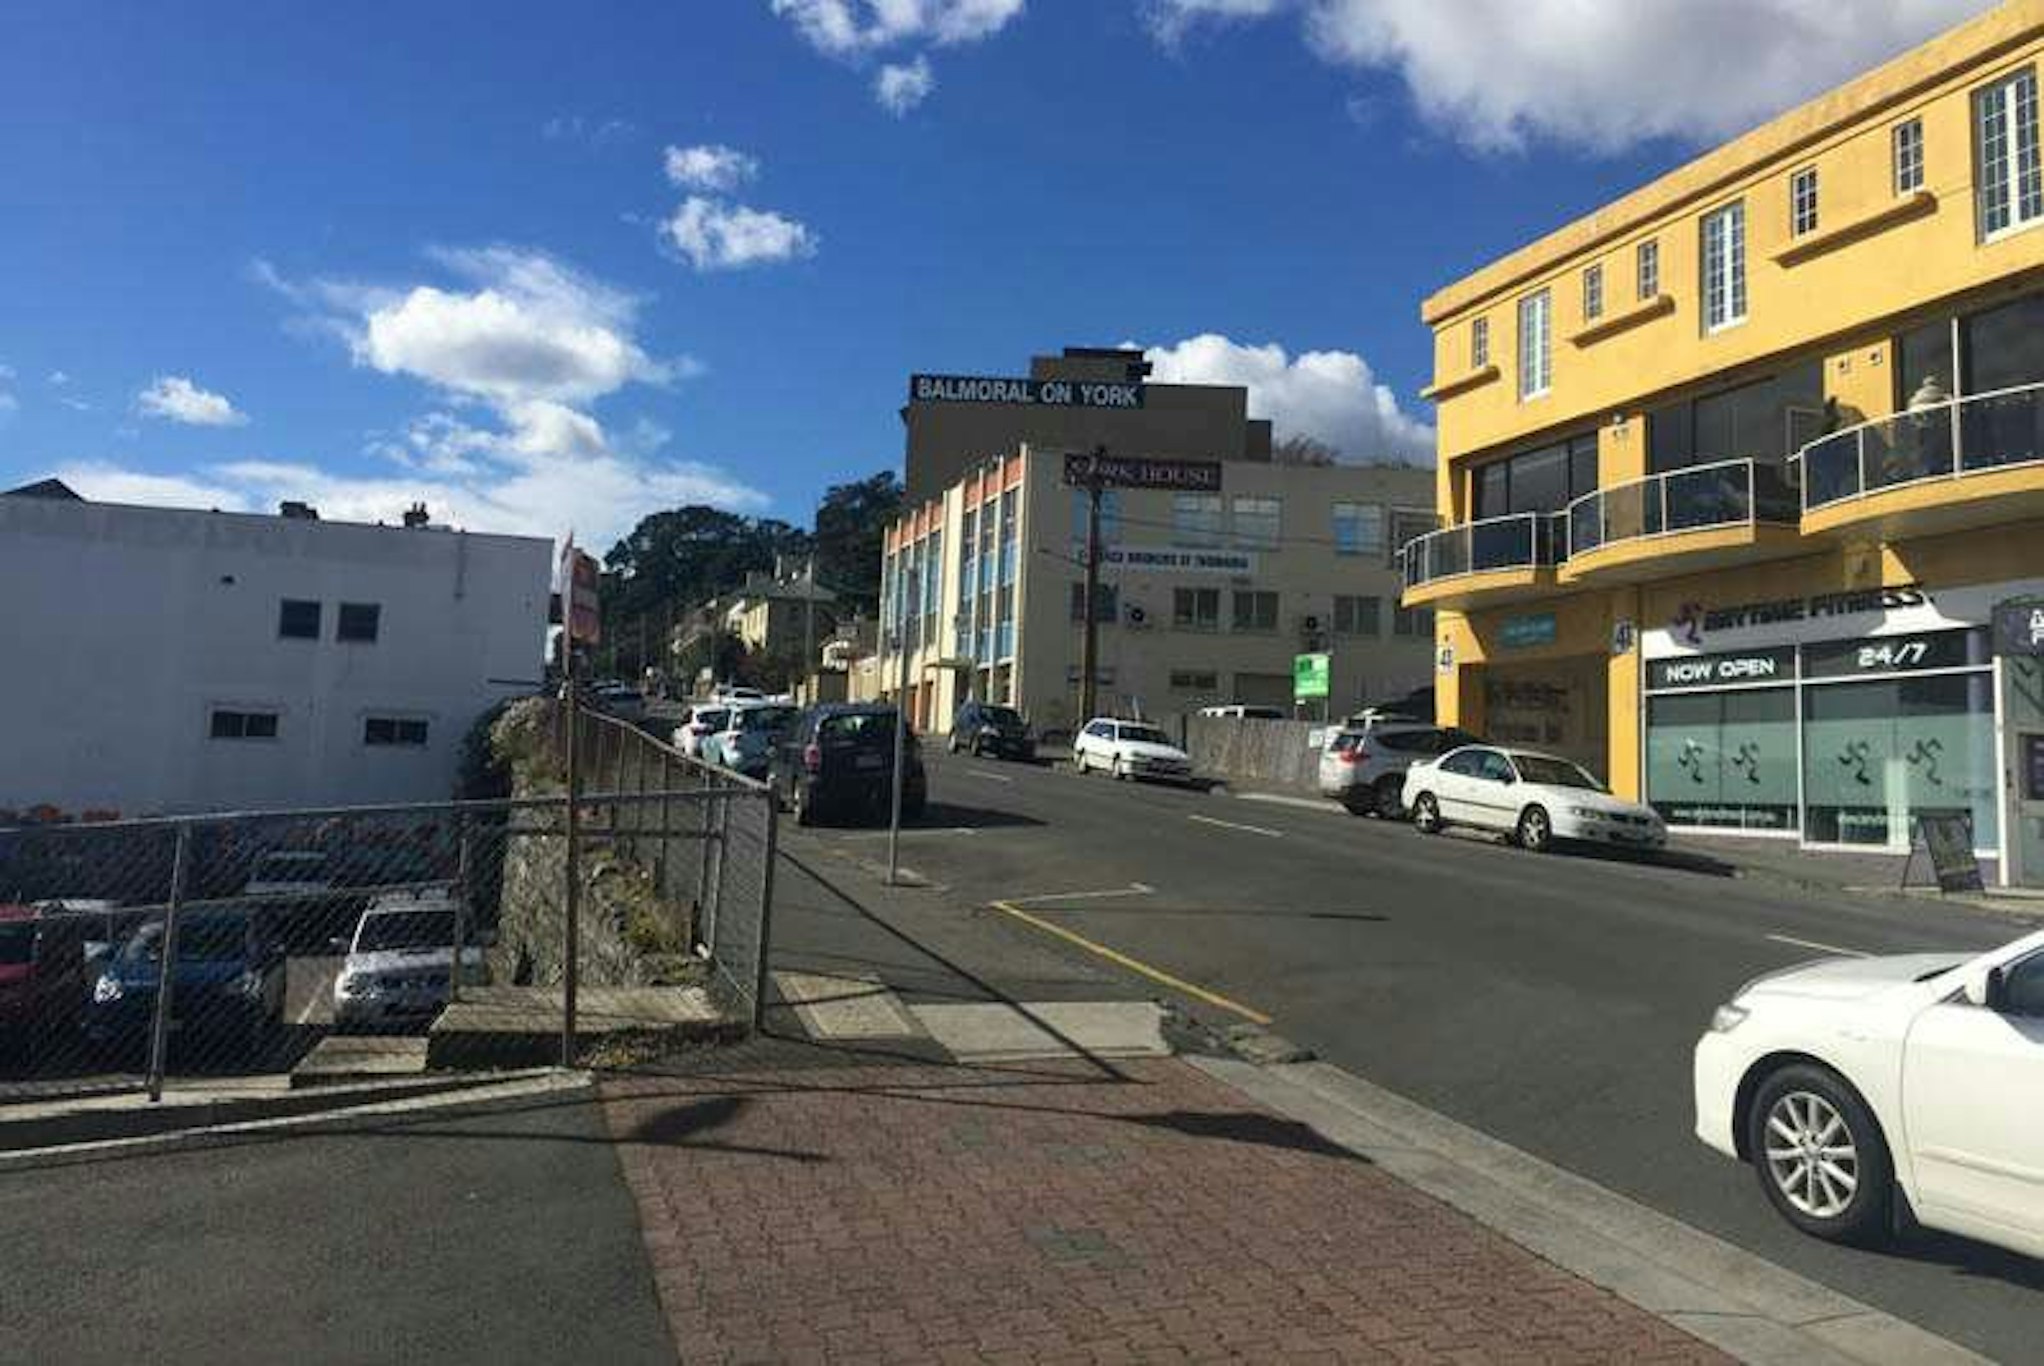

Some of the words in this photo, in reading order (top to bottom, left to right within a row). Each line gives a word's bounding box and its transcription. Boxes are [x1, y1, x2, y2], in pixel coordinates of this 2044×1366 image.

[917, 377, 1035, 402] BALMORAL
[1040, 382, 1073, 403] ON
[1080, 385, 1137, 406] YORK
[1857, 643, 1928, 668] 24/7
[1666, 662, 1712, 682] NOW
[1718, 658, 1775, 678] OPEN
